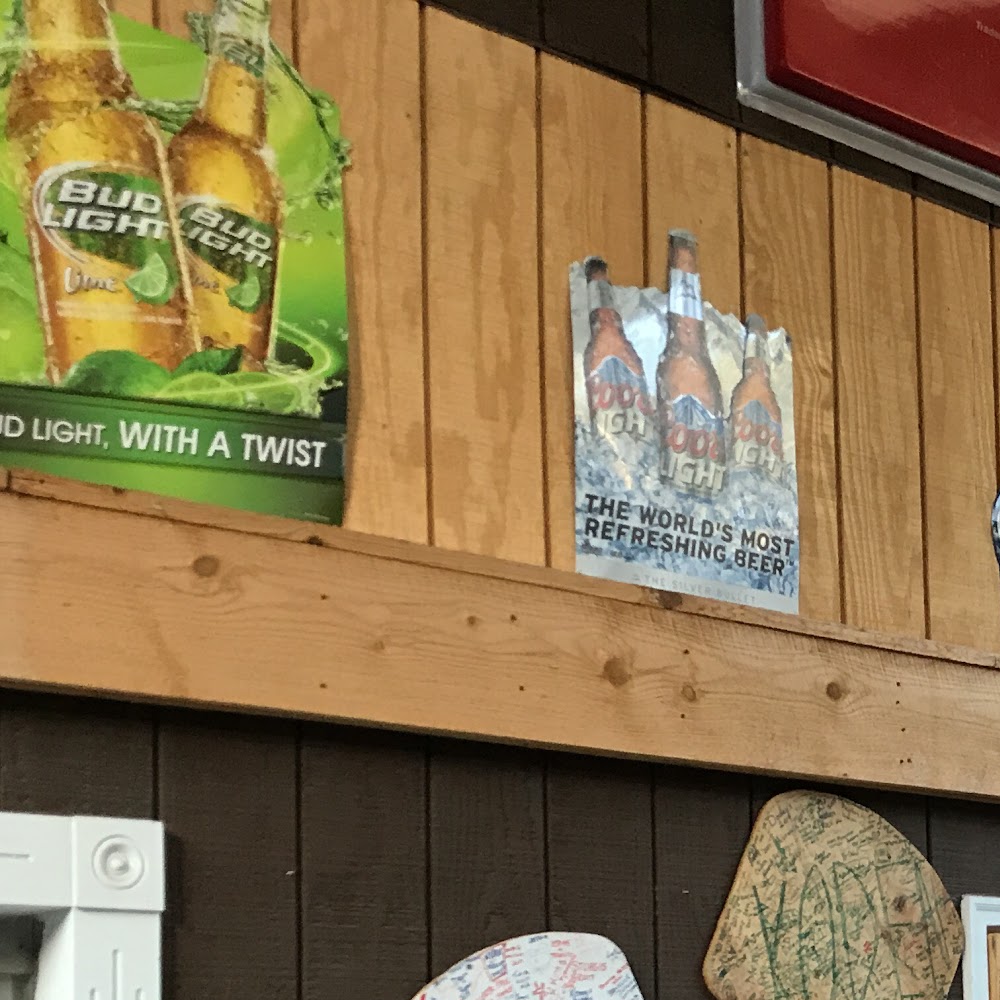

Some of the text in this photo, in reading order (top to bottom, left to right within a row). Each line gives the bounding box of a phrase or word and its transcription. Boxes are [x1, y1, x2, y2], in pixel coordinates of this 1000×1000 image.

[58, 179, 162, 214] BUD
[42, 203, 169, 240] LIGHT
[190, 206, 272, 250] BUD
[0, 414, 327, 468] D LIGHT, WITH A TWIST
[584, 517, 726, 563] REFRESHING
[585, 493, 795, 556] THE WORLD'S MOST
